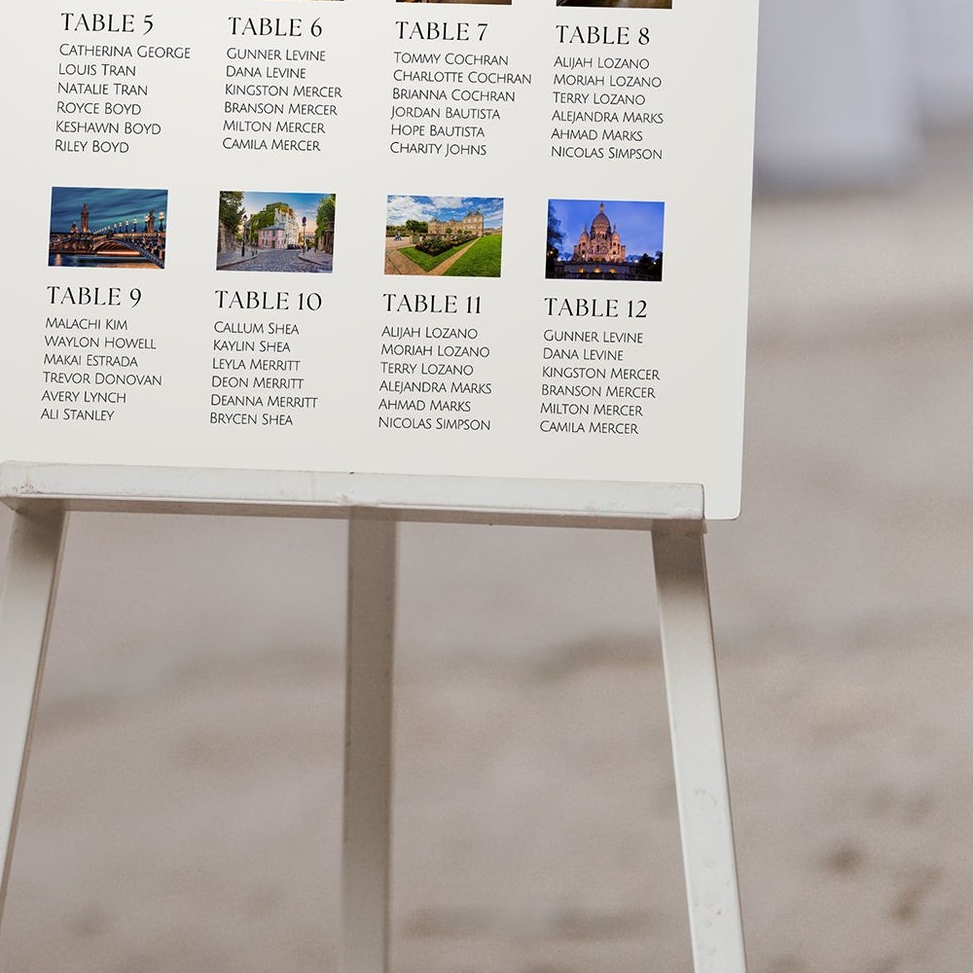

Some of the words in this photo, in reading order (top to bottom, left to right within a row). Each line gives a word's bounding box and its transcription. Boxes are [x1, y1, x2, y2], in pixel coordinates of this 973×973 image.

[61, 13, 134, 32] TABLE
[143, 14, 153, 35] 5
[228, 17, 302, 36] TABLE
[311, 17, 322, 37] 6
[395, 21, 469, 41] TABLE
[477, 23, 488, 41] 7
[556, 25, 629, 45] TABLE
[638, 27, 649, 45] 8
[47, 286, 121, 305] TABLE
[130, 288, 141, 308] 9
[215, 290, 289, 310] TABLE
[299, 293, 322, 311] 10
[383, 294, 457, 313] TABLE
[467, 296, 480, 314] 11
[544, 298, 618, 317] TABLE
[628, 300, 647, 318] 12
